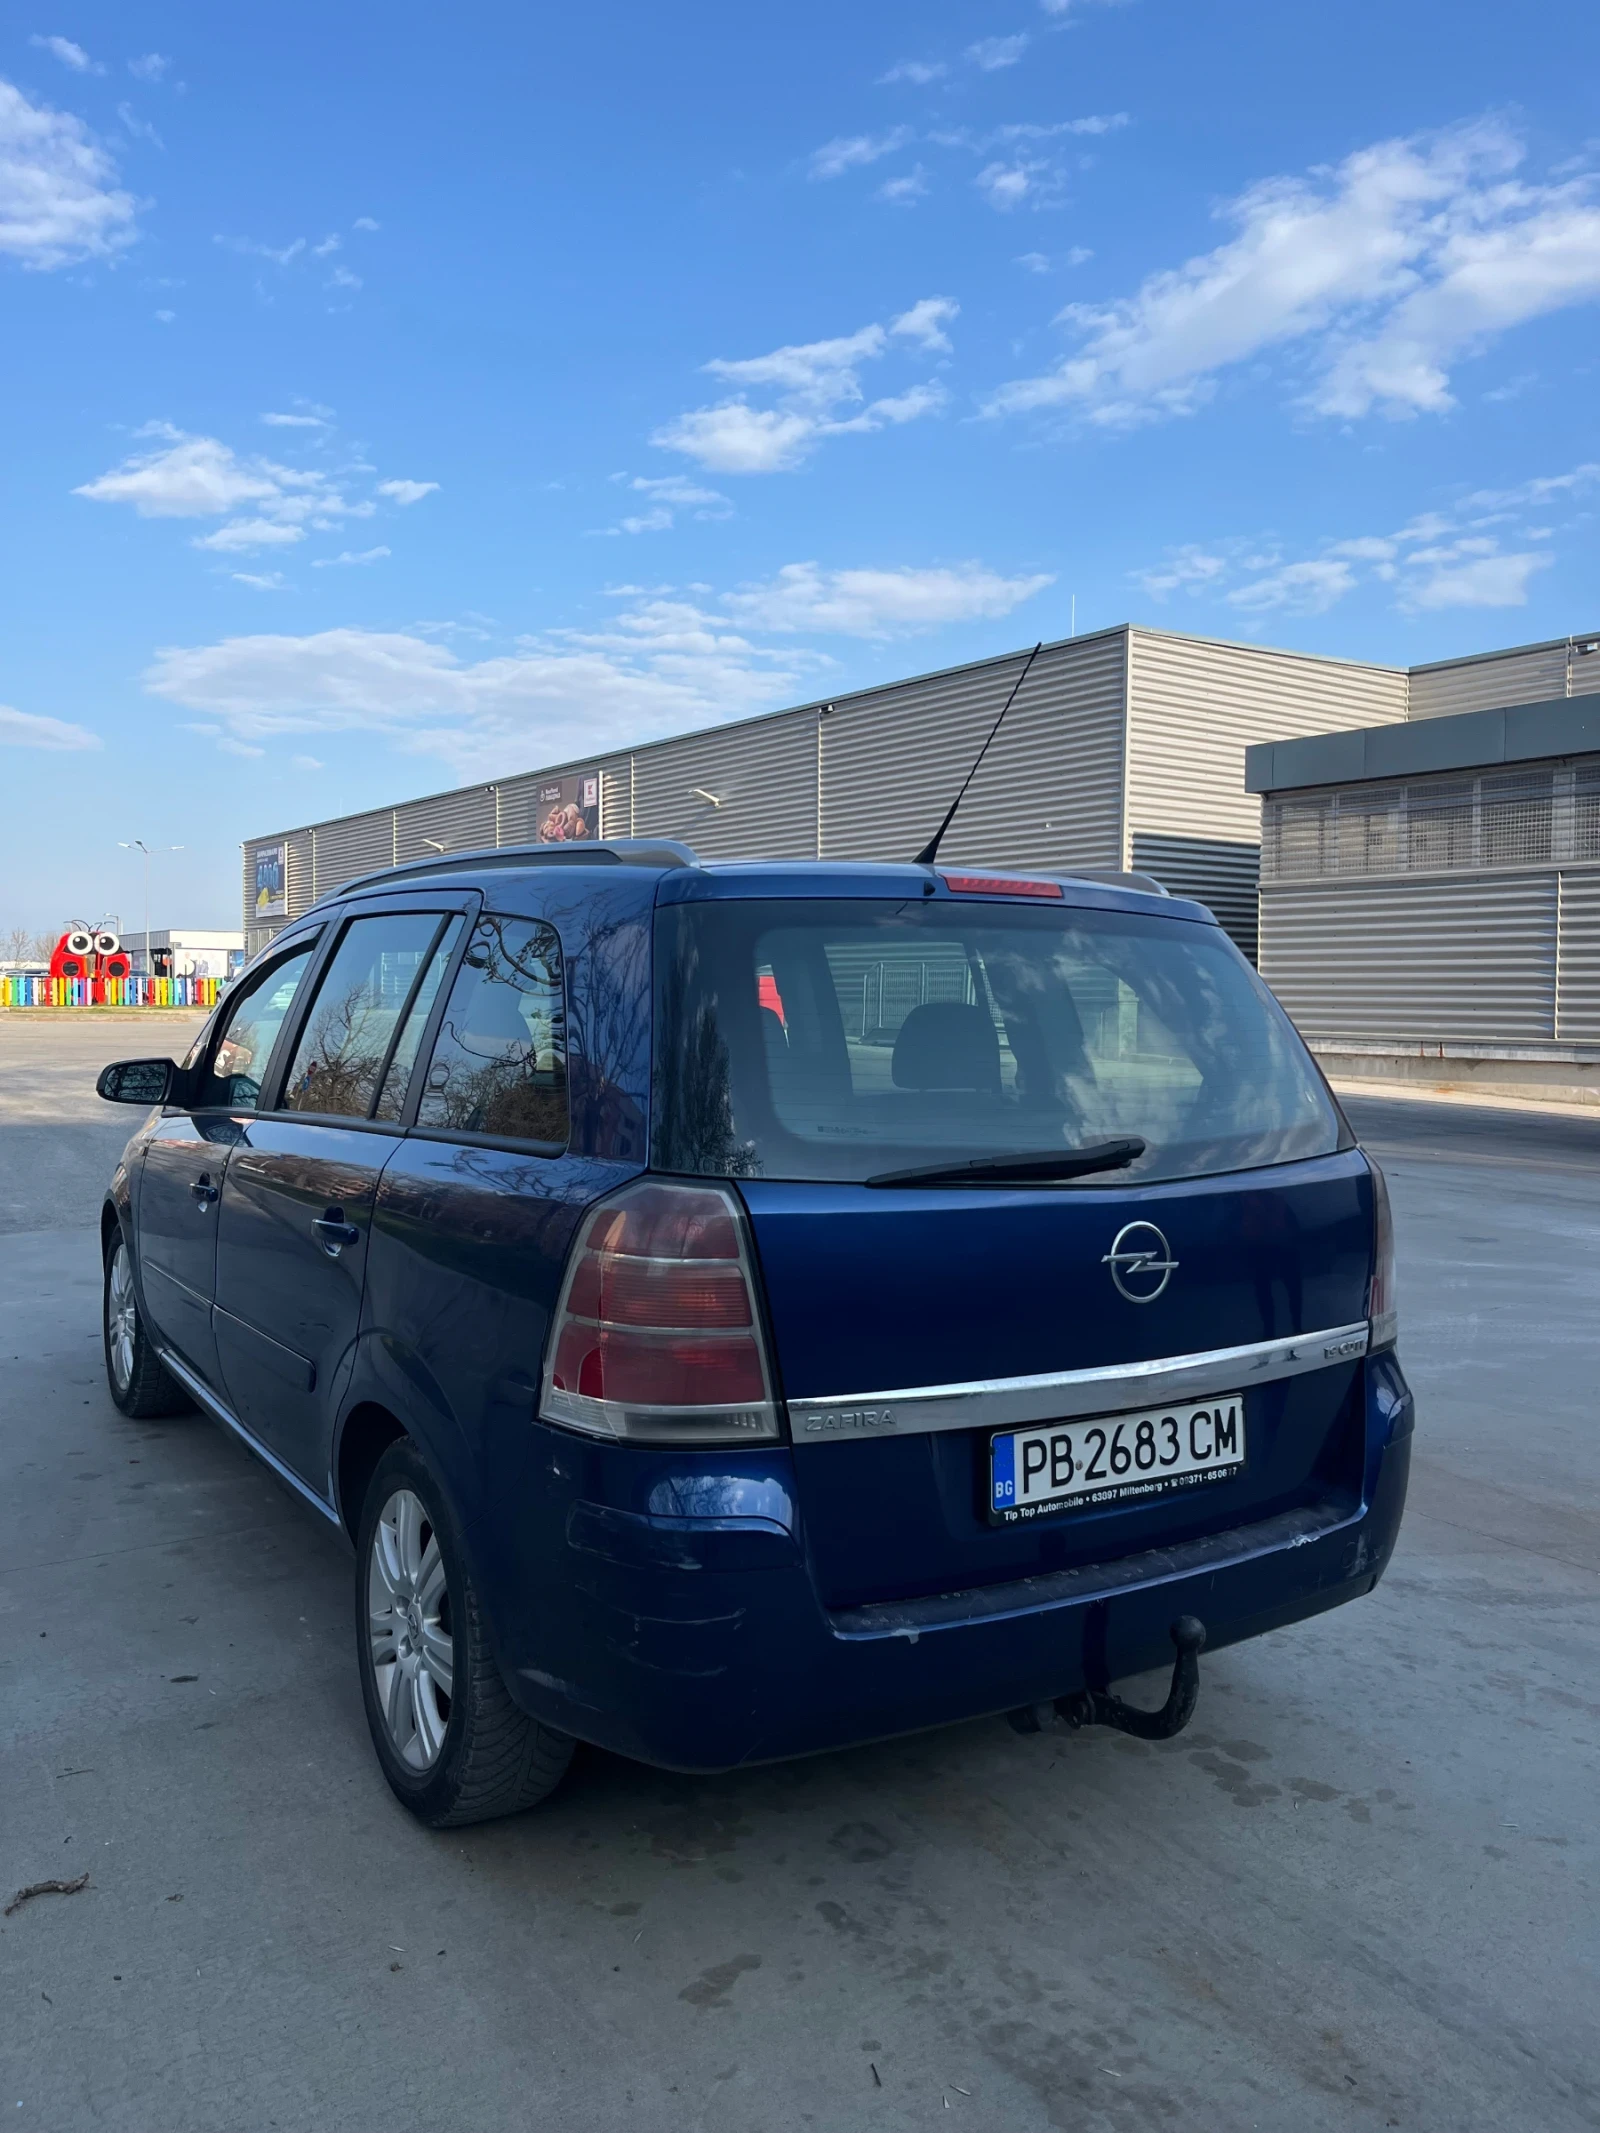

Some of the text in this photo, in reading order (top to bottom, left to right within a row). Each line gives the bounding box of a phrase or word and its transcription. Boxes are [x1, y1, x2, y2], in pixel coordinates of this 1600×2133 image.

[806, 1409, 896, 1431] ZAFIRA
[1022, 1405, 1237, 1494] PB 2683 CM
[995, 1480, 1013, 1498] BG
[1004, 1510, 1018, 1521] Tip
[1020, 1507, 1035, 1518] Top
[1037, 1496, 1084, 1514] Automobile
[1091, 1489, 1117, 1502] 63897
[1119, 1483, 1163, 1497] Miltenberg
